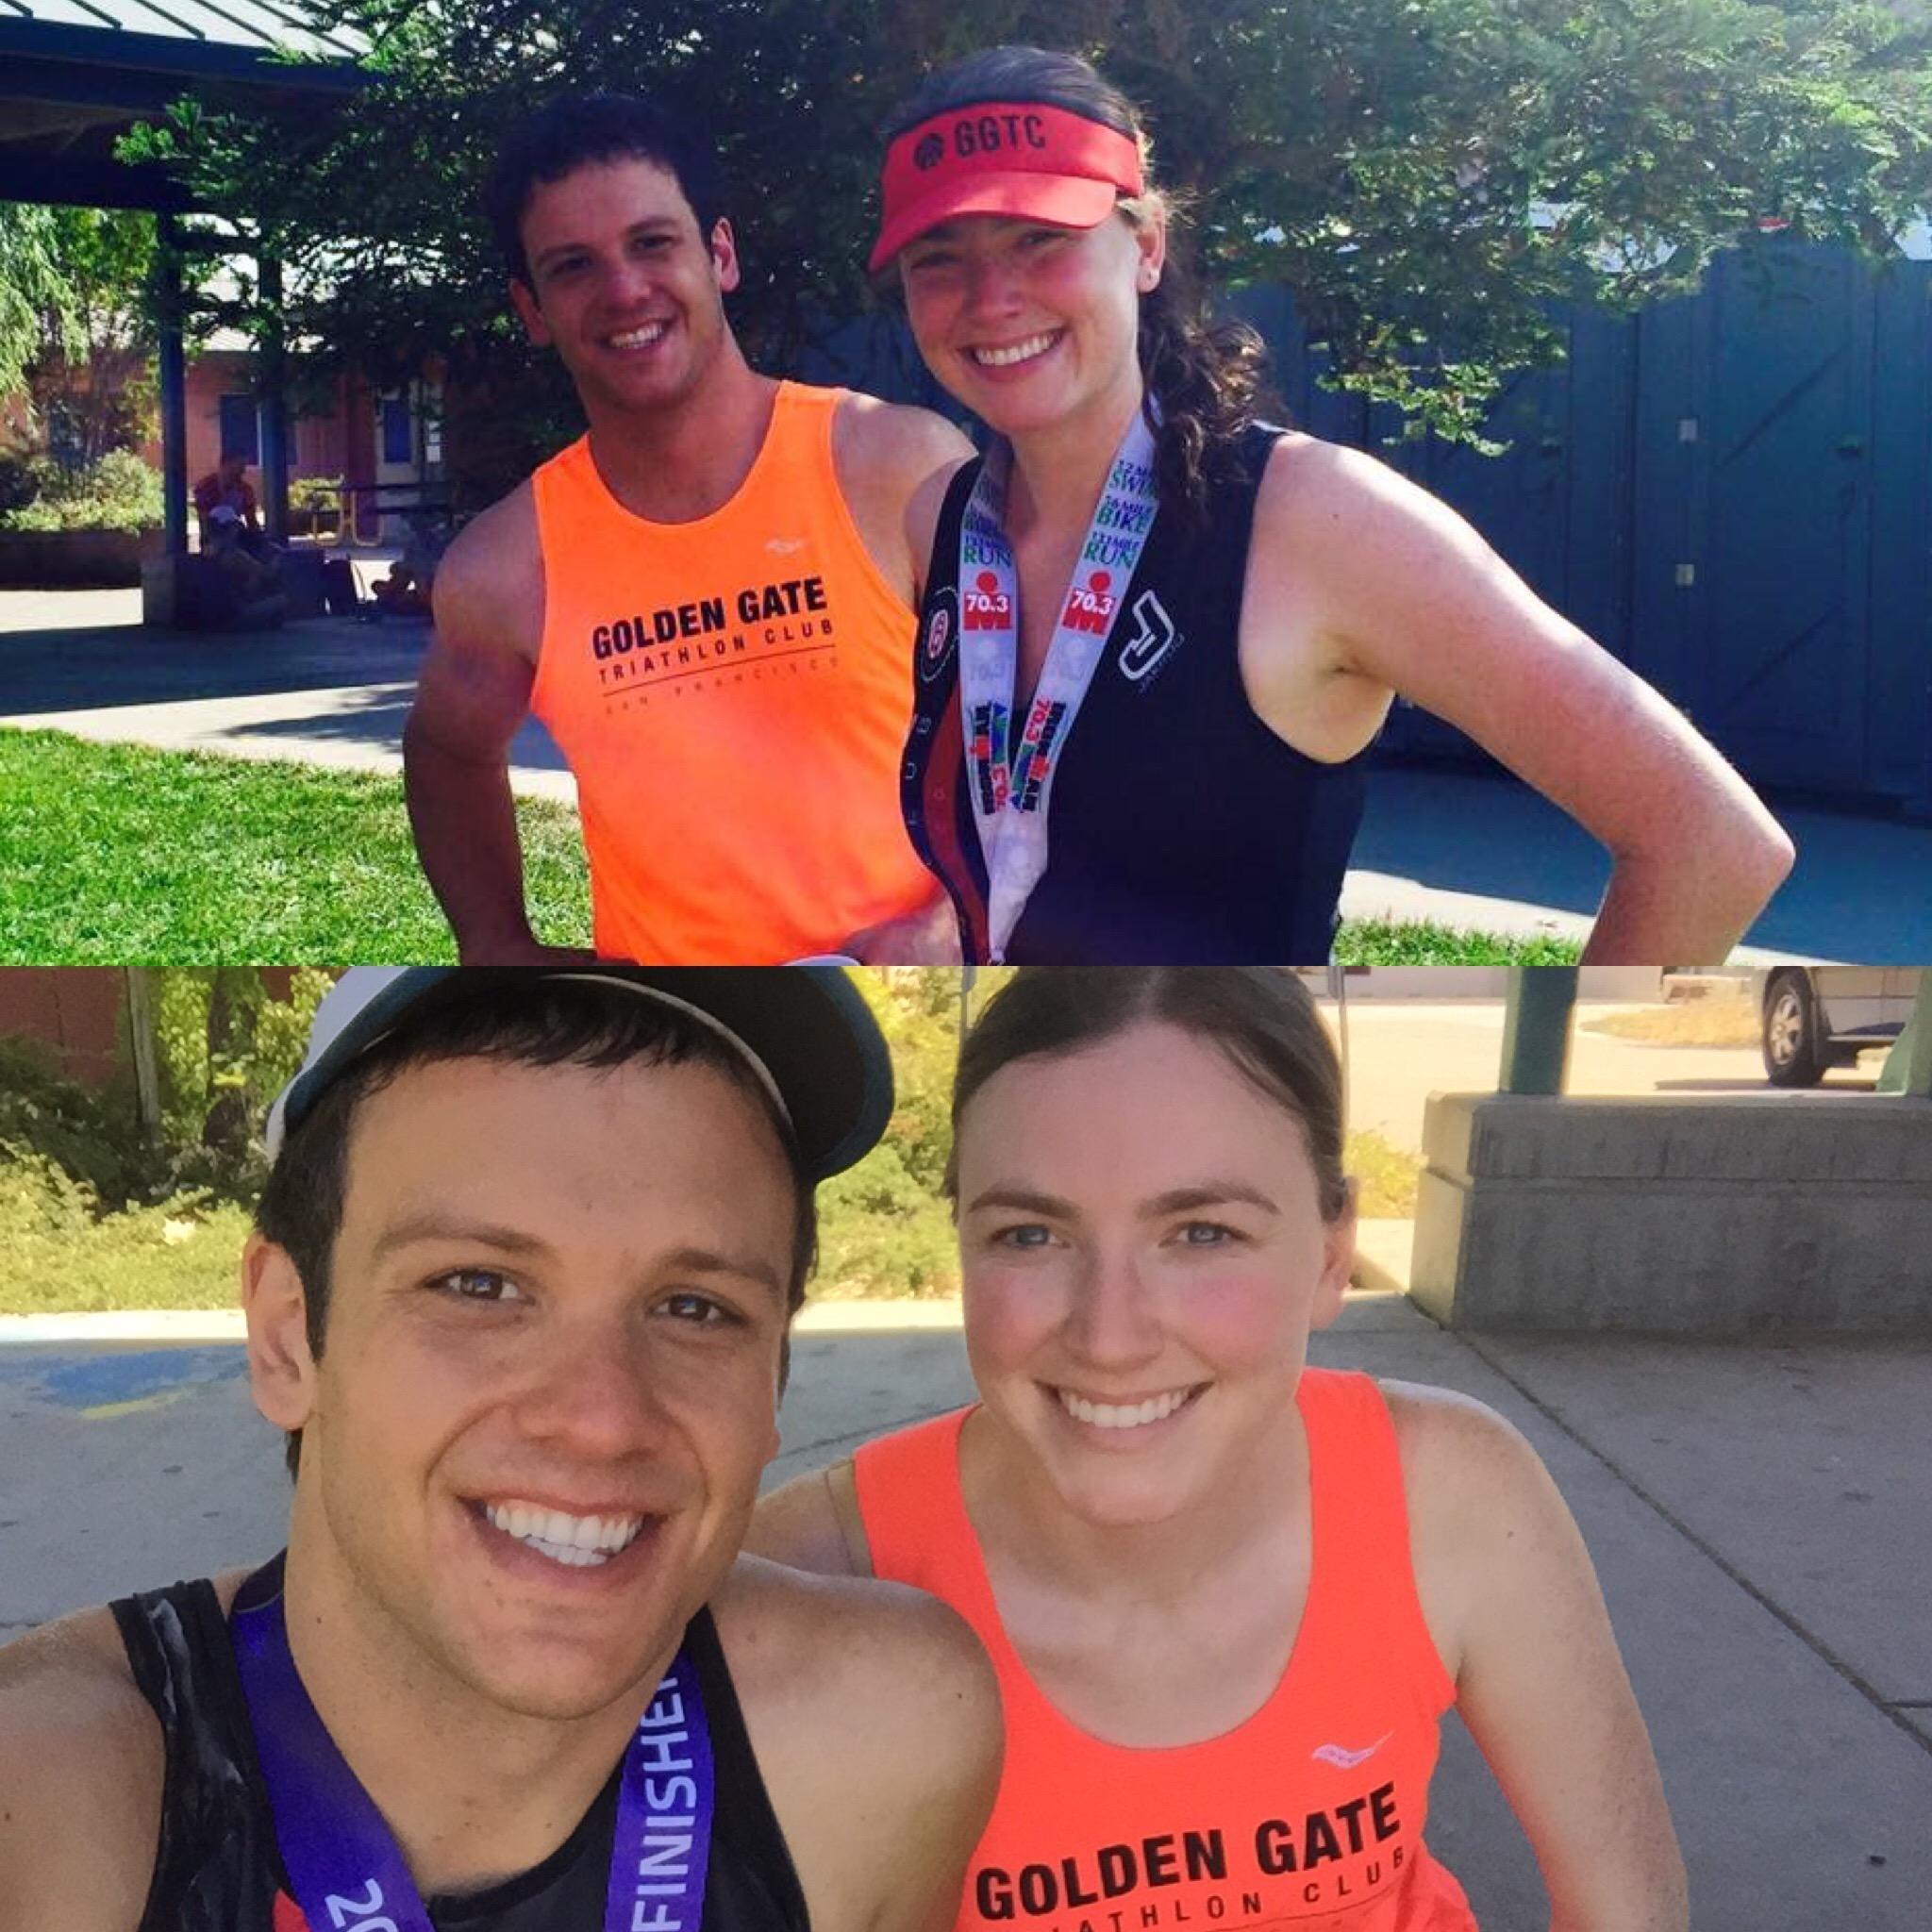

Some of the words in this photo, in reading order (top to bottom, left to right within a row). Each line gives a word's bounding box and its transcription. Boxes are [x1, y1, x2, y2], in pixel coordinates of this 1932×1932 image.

[954, 114, 1046, 158] GGTC
[1097, 505, 1152, 534] BIKE
[964, 545, 1012, 568] RUN
[1085, 541, 1137, 569] RUN
[592, 597, 726, 660] GOLDEN
[737, 576, 828, 625] GATE
[965, 593, 1009, 613] 70.3
[1071, 590, 1113, 614] 70.3
[599, 635, 745, 684] TRIATHLON
[764, 619, 833, 644] CLUB
[975, 1828, 1227, 1921] GOLDEN
[1255, 1781, 1402, 1875] GATE
[1052, 1891, 1262, 1932] ATHLON
[1303, 1850, 1404, 1904] CLUB
